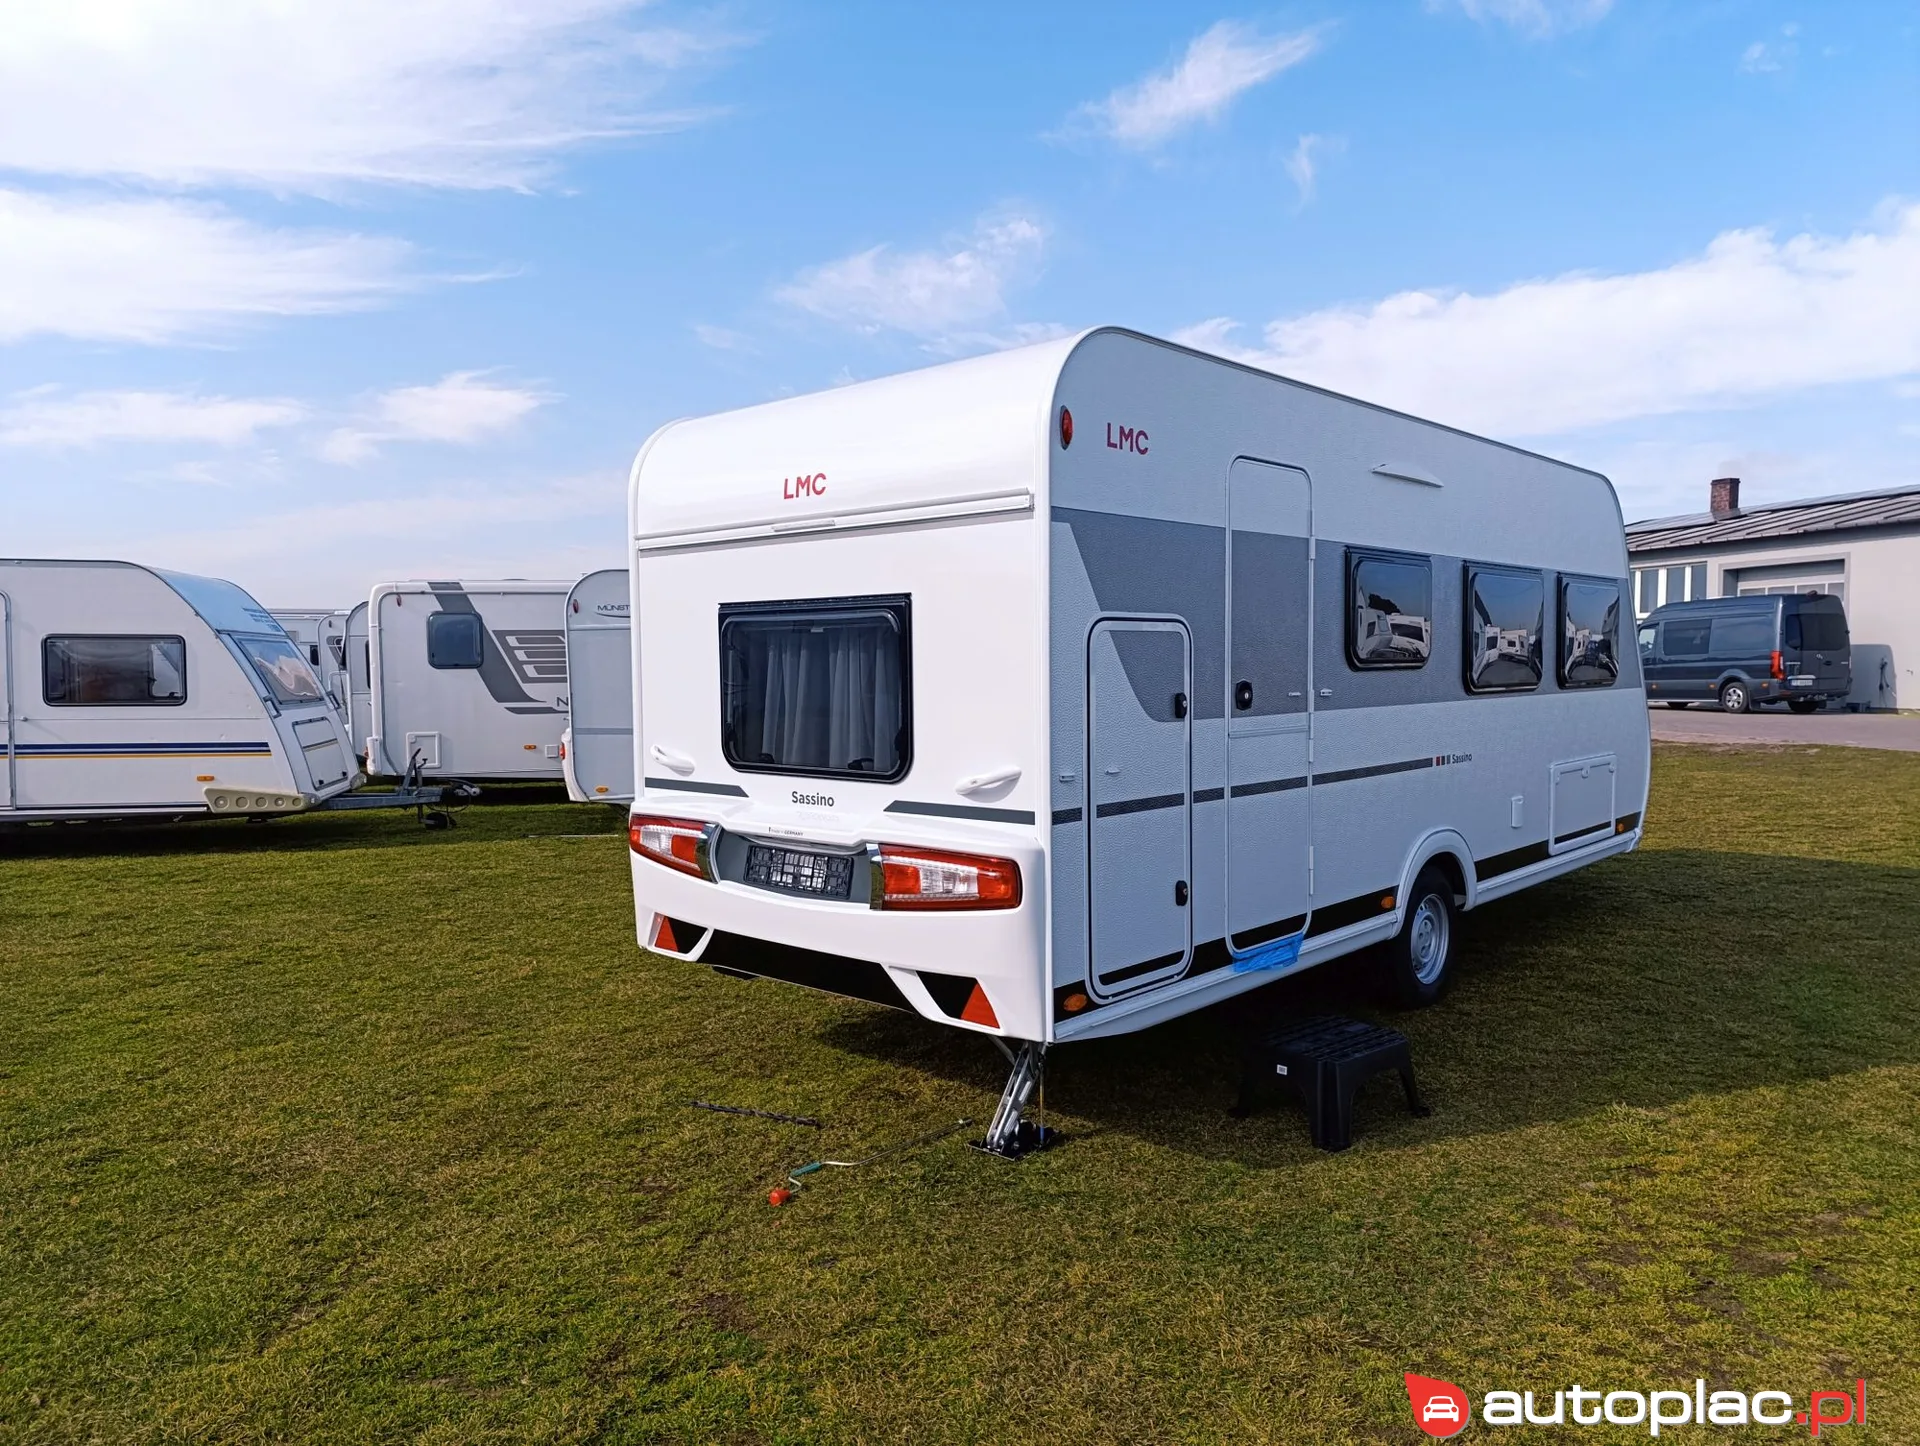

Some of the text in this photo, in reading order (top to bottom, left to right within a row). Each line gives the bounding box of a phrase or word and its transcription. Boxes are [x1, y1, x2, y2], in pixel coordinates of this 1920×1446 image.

[1106, 422, 1149, 455] LMC
[783, 472, 827, 500] LMC
[1451, 752, 1473, 764] Sassino
[791, 790, 835, 807] Sassino
